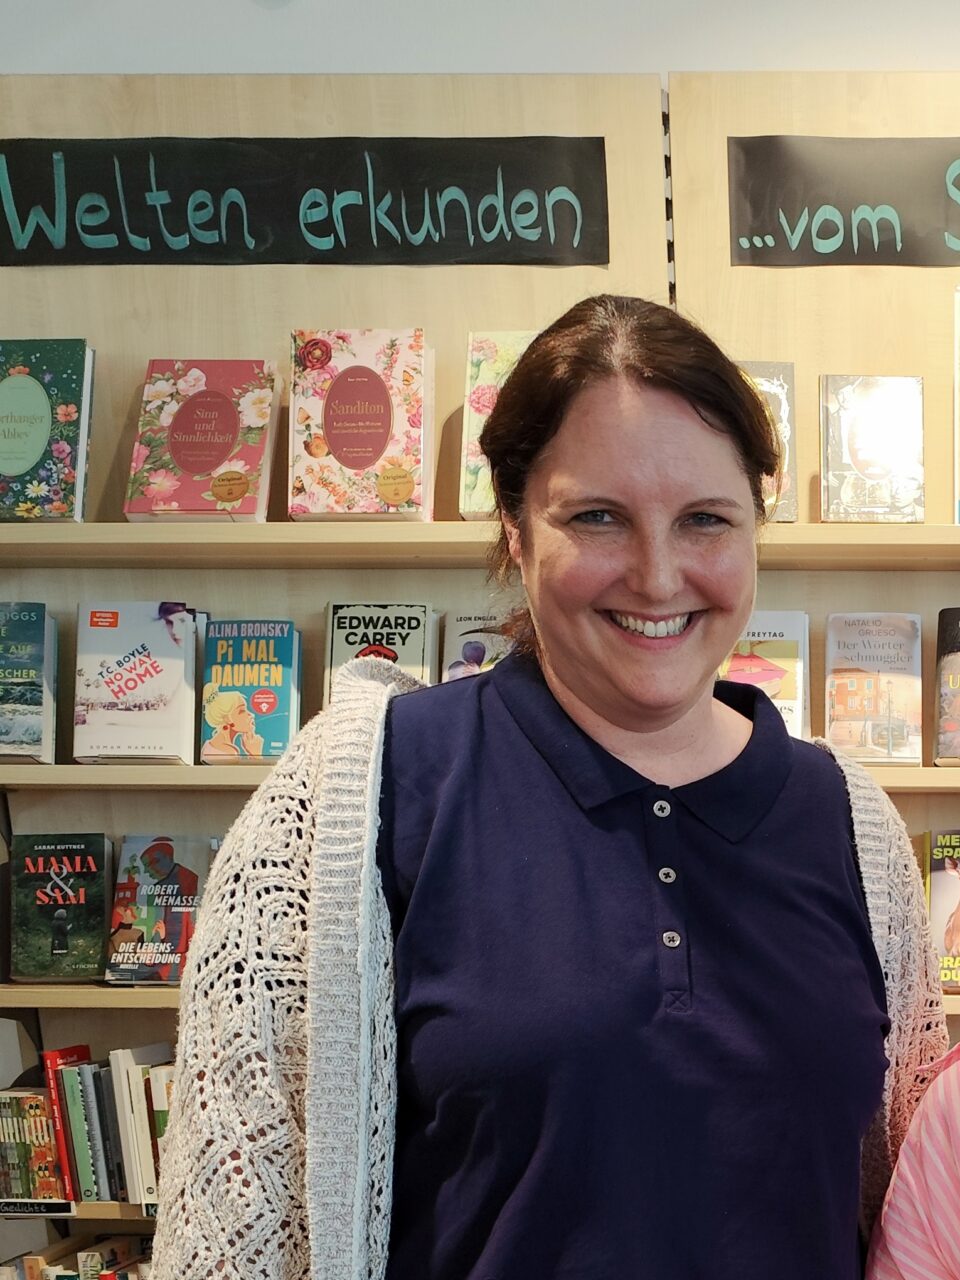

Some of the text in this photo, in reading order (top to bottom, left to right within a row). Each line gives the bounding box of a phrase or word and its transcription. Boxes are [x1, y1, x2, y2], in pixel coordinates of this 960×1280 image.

[0, 150, 583, 251] Welten erkunden
[194, 408, 218, 419] Sinn
[330, 400, 384, 416] Sanditon
[194, 420, 215, 430] und
[172, 432, 233, 443] Sinnlichkeit
[336, 615, 420, 630] EDWARD
[844, 619, 882, 627] NATALIO
[208, 622, 290, 638] ALINA BRONSKY
[858, 628, 896, 637] GRUESO
[344, 632, 410, 646] CAREY
[836, 639, 905, 650] Der Wörter
[216, 639, 278, 662] Pi MAL
[98, 642, 150, 680] T.C. BOYLE
[844, 652, 914, 665] schmuggler
[103, 651, 153, 689] NO WAY
[211, 665, 283, 688] DAUMEN
[110, 660, 164, 701] HOME
[24, 855, 98, 874] MAMA
[35, 887, 86, 905] SAM
[140, 884, 180, 896] ROBERT
[153, 895, 201, 907] MENASSE
[119, 942, 175, 953] DIE LEBENS-
[110, 953, 181, 965] ENTSCHEIDUNG
